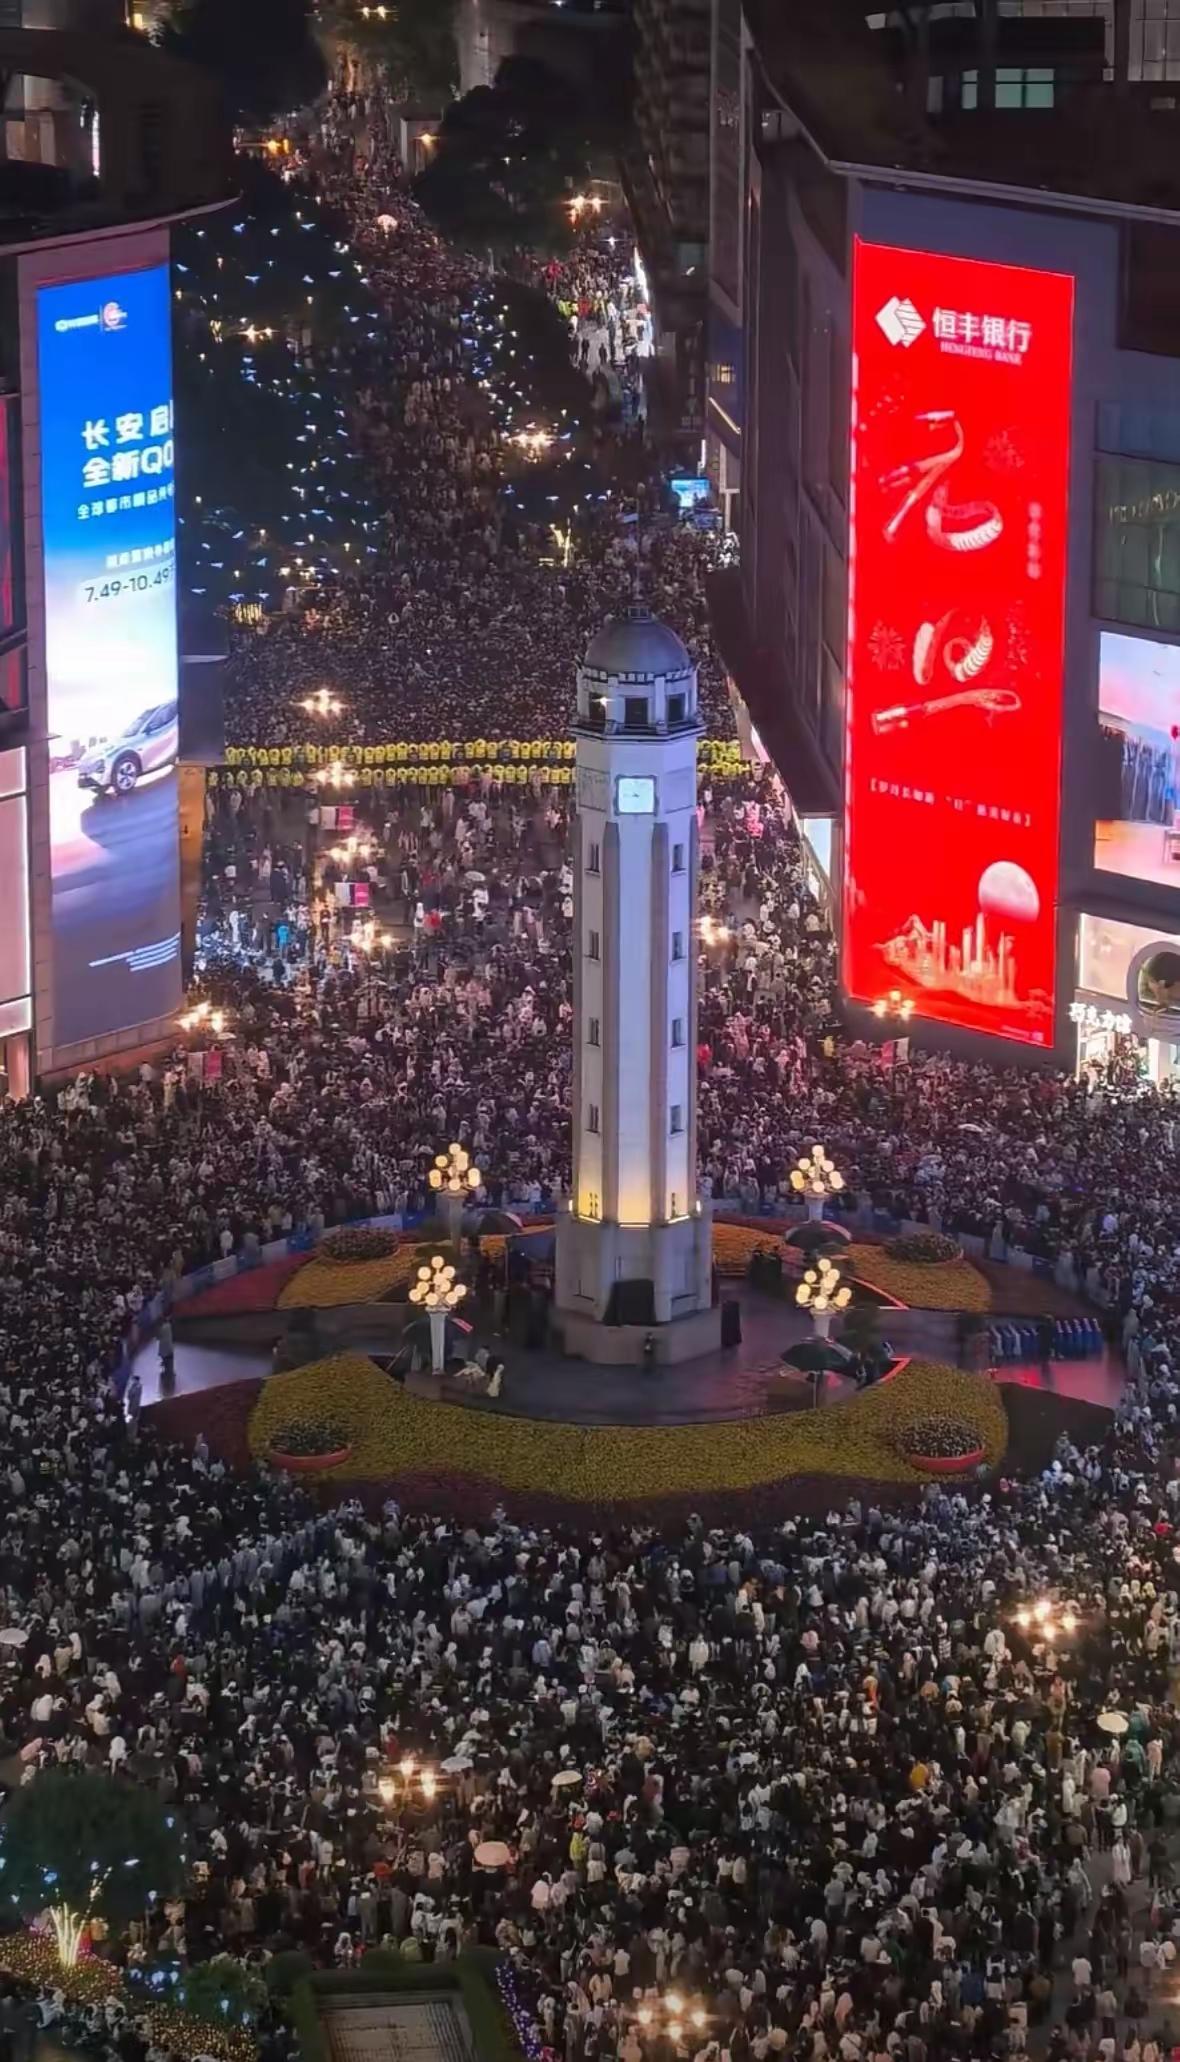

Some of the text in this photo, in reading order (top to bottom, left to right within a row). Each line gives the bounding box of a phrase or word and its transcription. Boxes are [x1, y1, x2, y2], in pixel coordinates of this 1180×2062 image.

[932, 306, 1032, 352] 恒丰银行
[81, 401, 173, 450] 长安启
